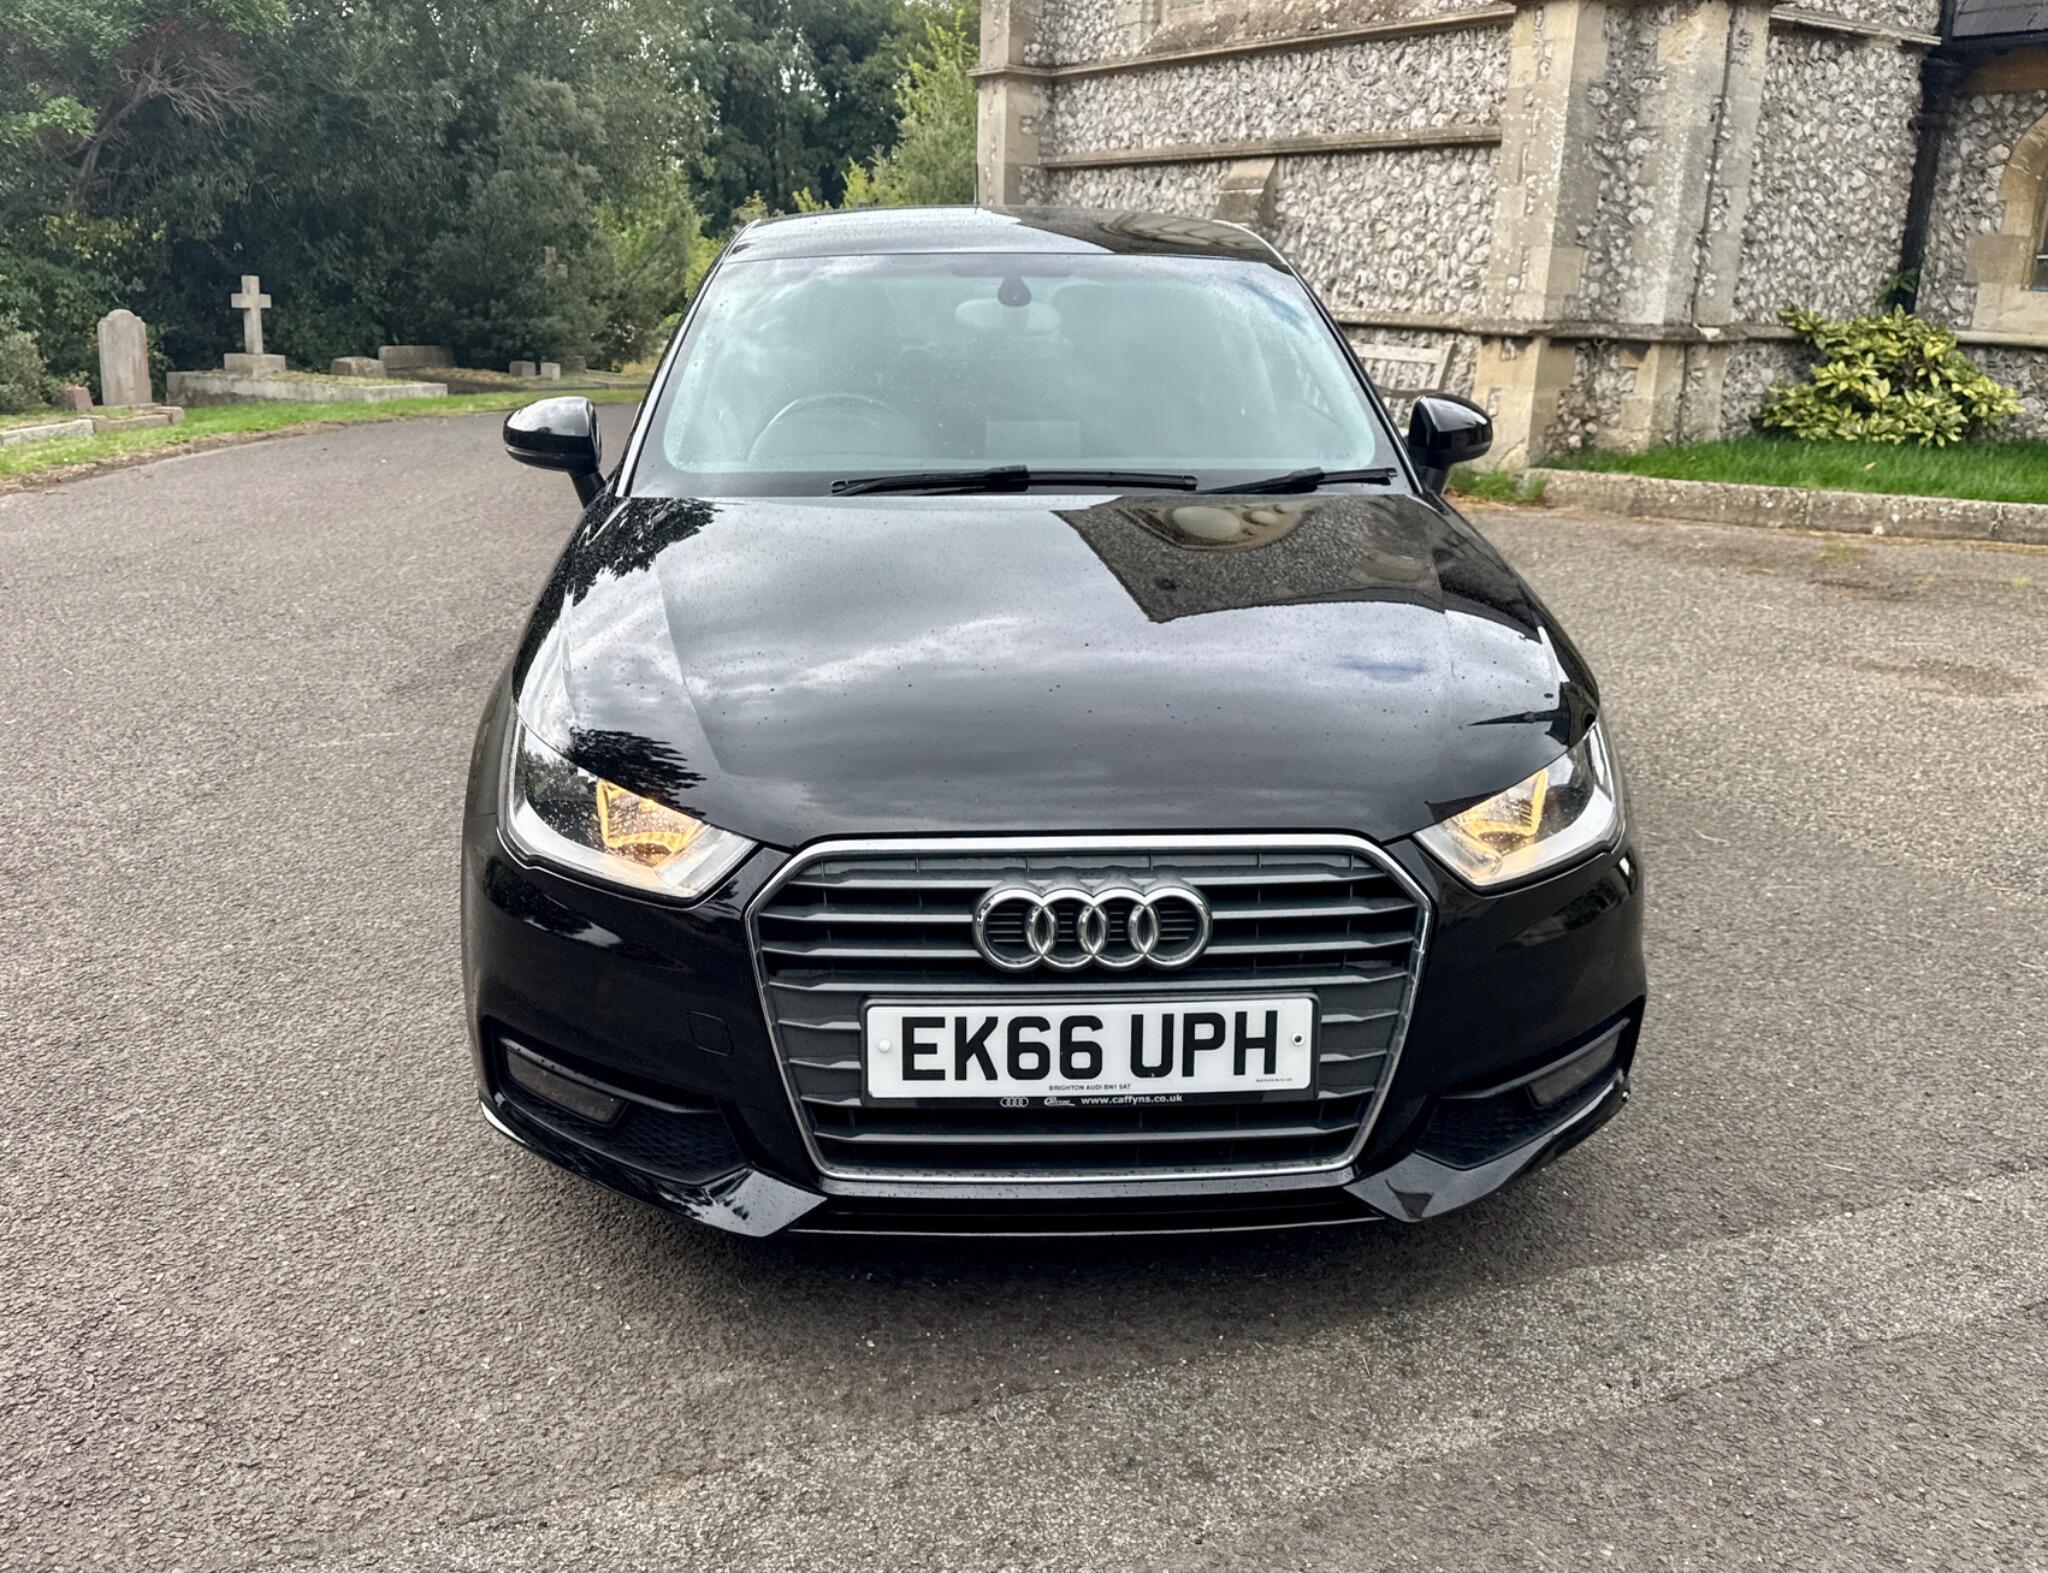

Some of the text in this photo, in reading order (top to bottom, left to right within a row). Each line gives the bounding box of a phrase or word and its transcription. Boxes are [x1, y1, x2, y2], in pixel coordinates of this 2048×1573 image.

[901, 1010, 1279, 1081] EK66 UPH
[1081, 1094, 1183, 1105] www.caffyns.co.uk
